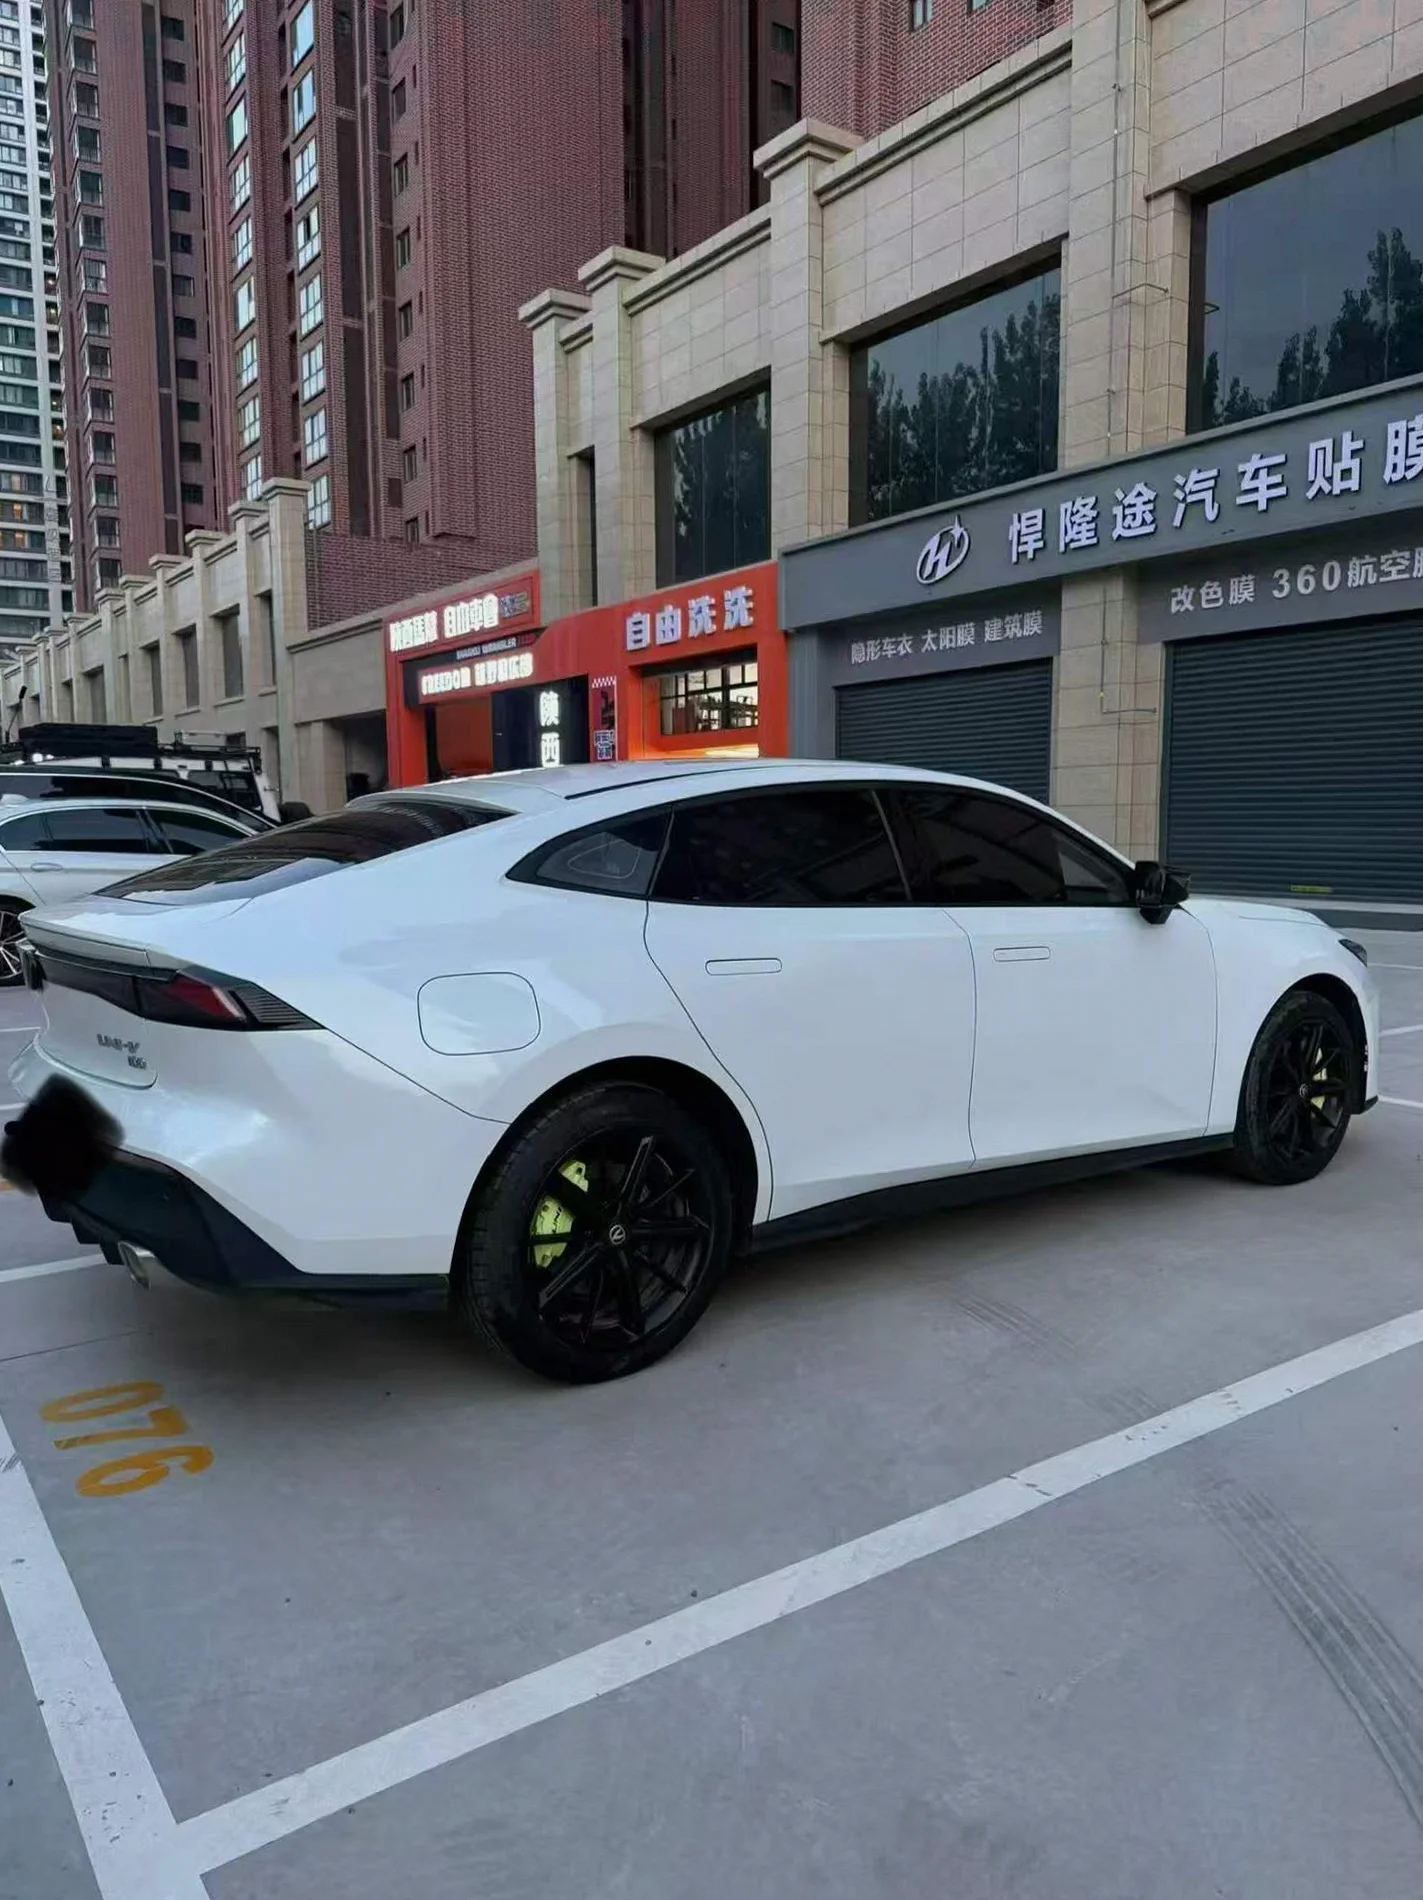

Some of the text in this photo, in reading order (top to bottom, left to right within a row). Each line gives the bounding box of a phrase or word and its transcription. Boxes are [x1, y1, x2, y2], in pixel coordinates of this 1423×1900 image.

[1008, 414, 1423, 564] 悍隆途汽车贴膜
[625, 586, 754, 651] 自由洗洗
[1170, 574, 1256, 613] 改色膜
[851, 610, 1043, 665] 隐形车衣 太阳膜 建筑膜
[38, 1381, 215, 1497] 076
